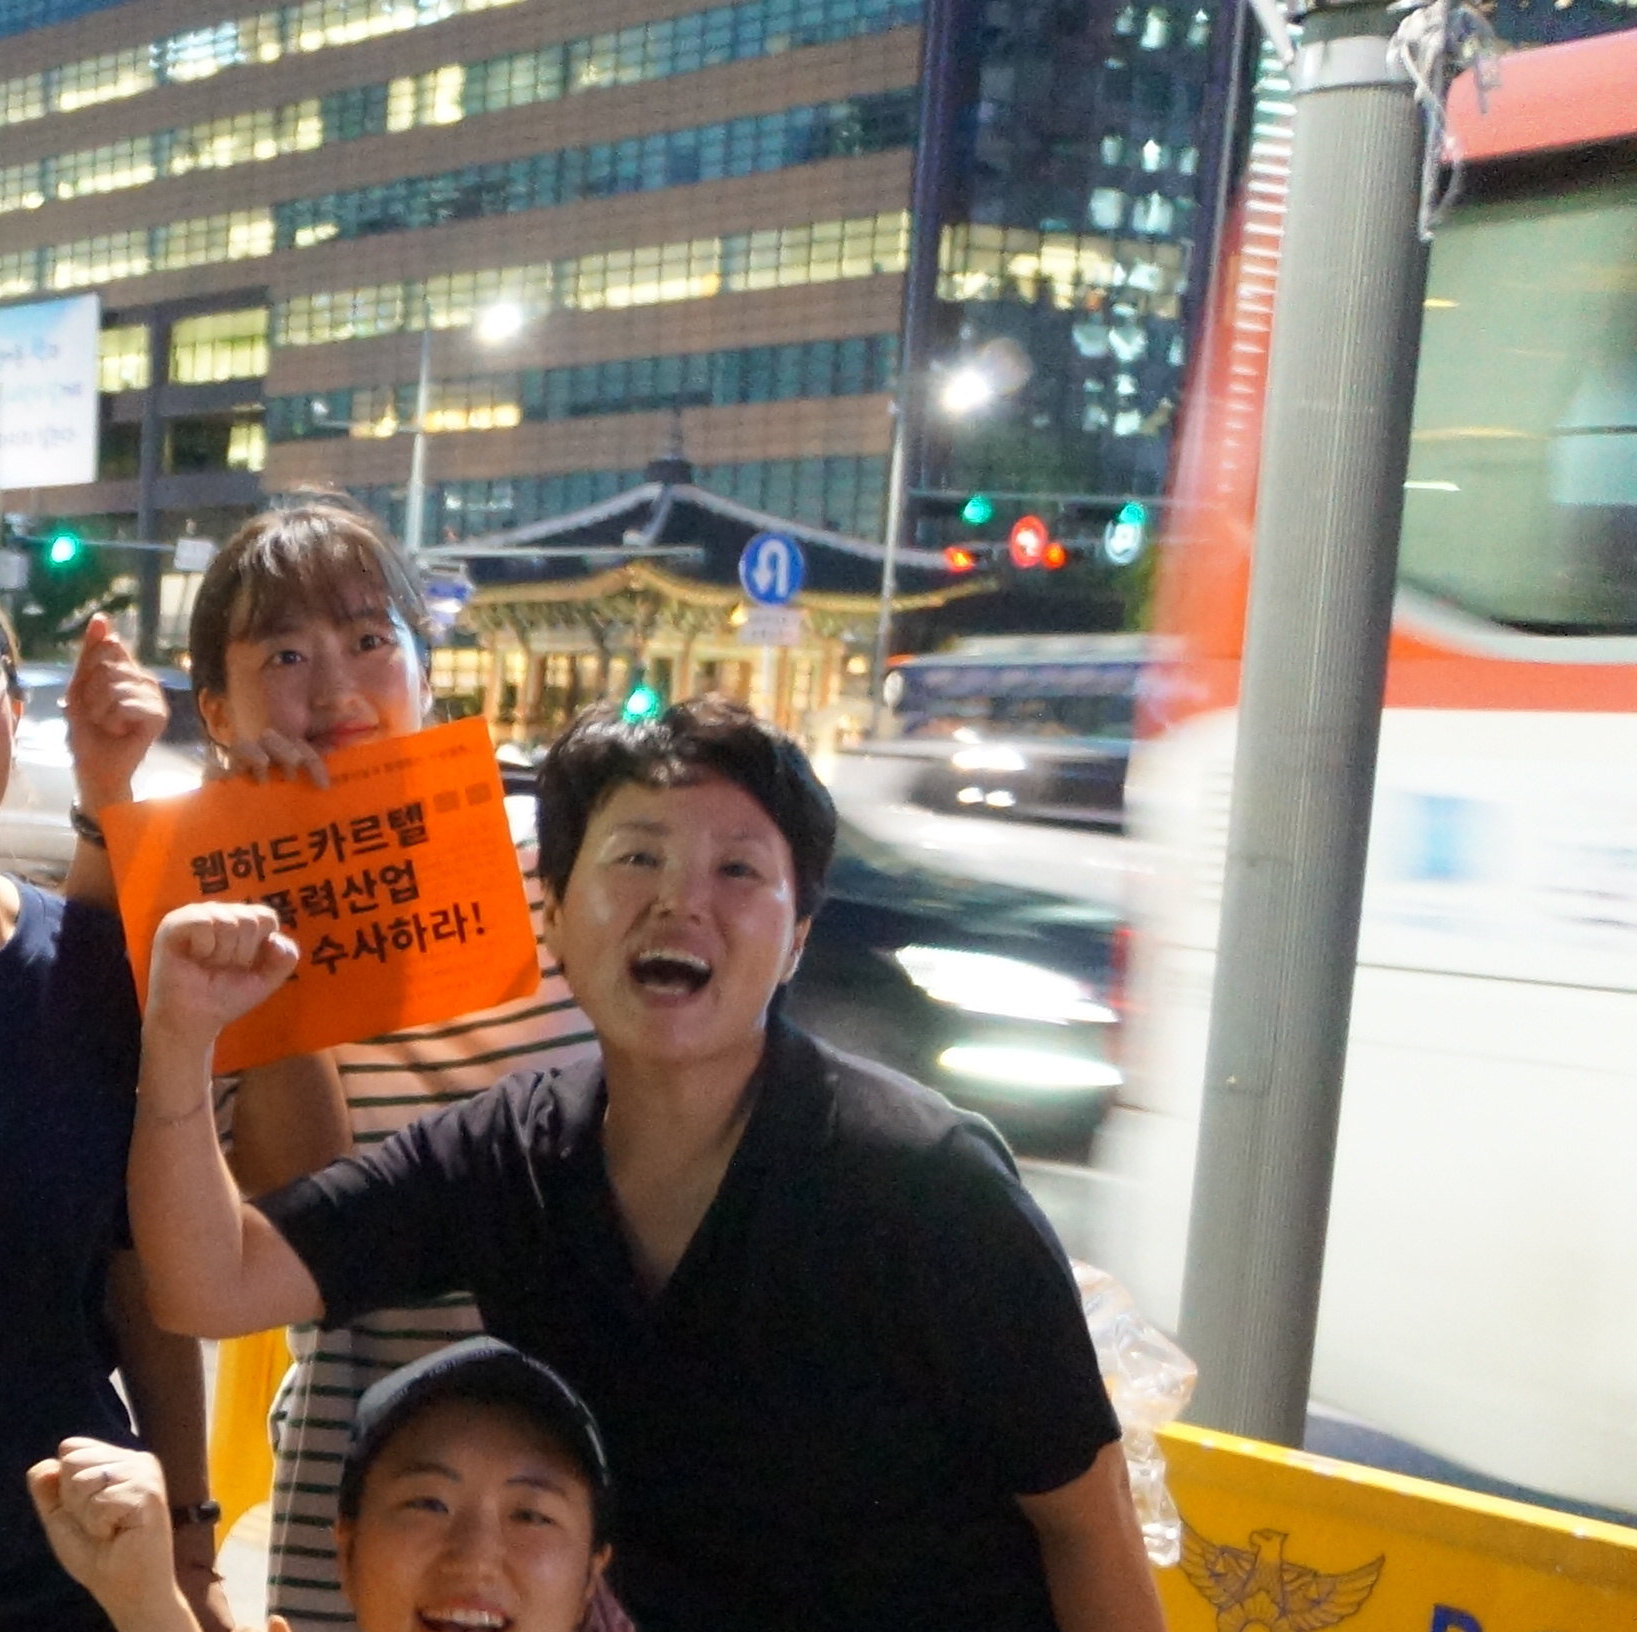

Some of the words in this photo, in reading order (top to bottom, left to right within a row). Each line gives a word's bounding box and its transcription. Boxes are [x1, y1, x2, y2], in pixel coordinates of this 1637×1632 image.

[189, 801, 431, 895] 웹하드카르텔
[245, 859, 420, 931] 폭력산업
[310, 902, 486, 976] 수사하라!
